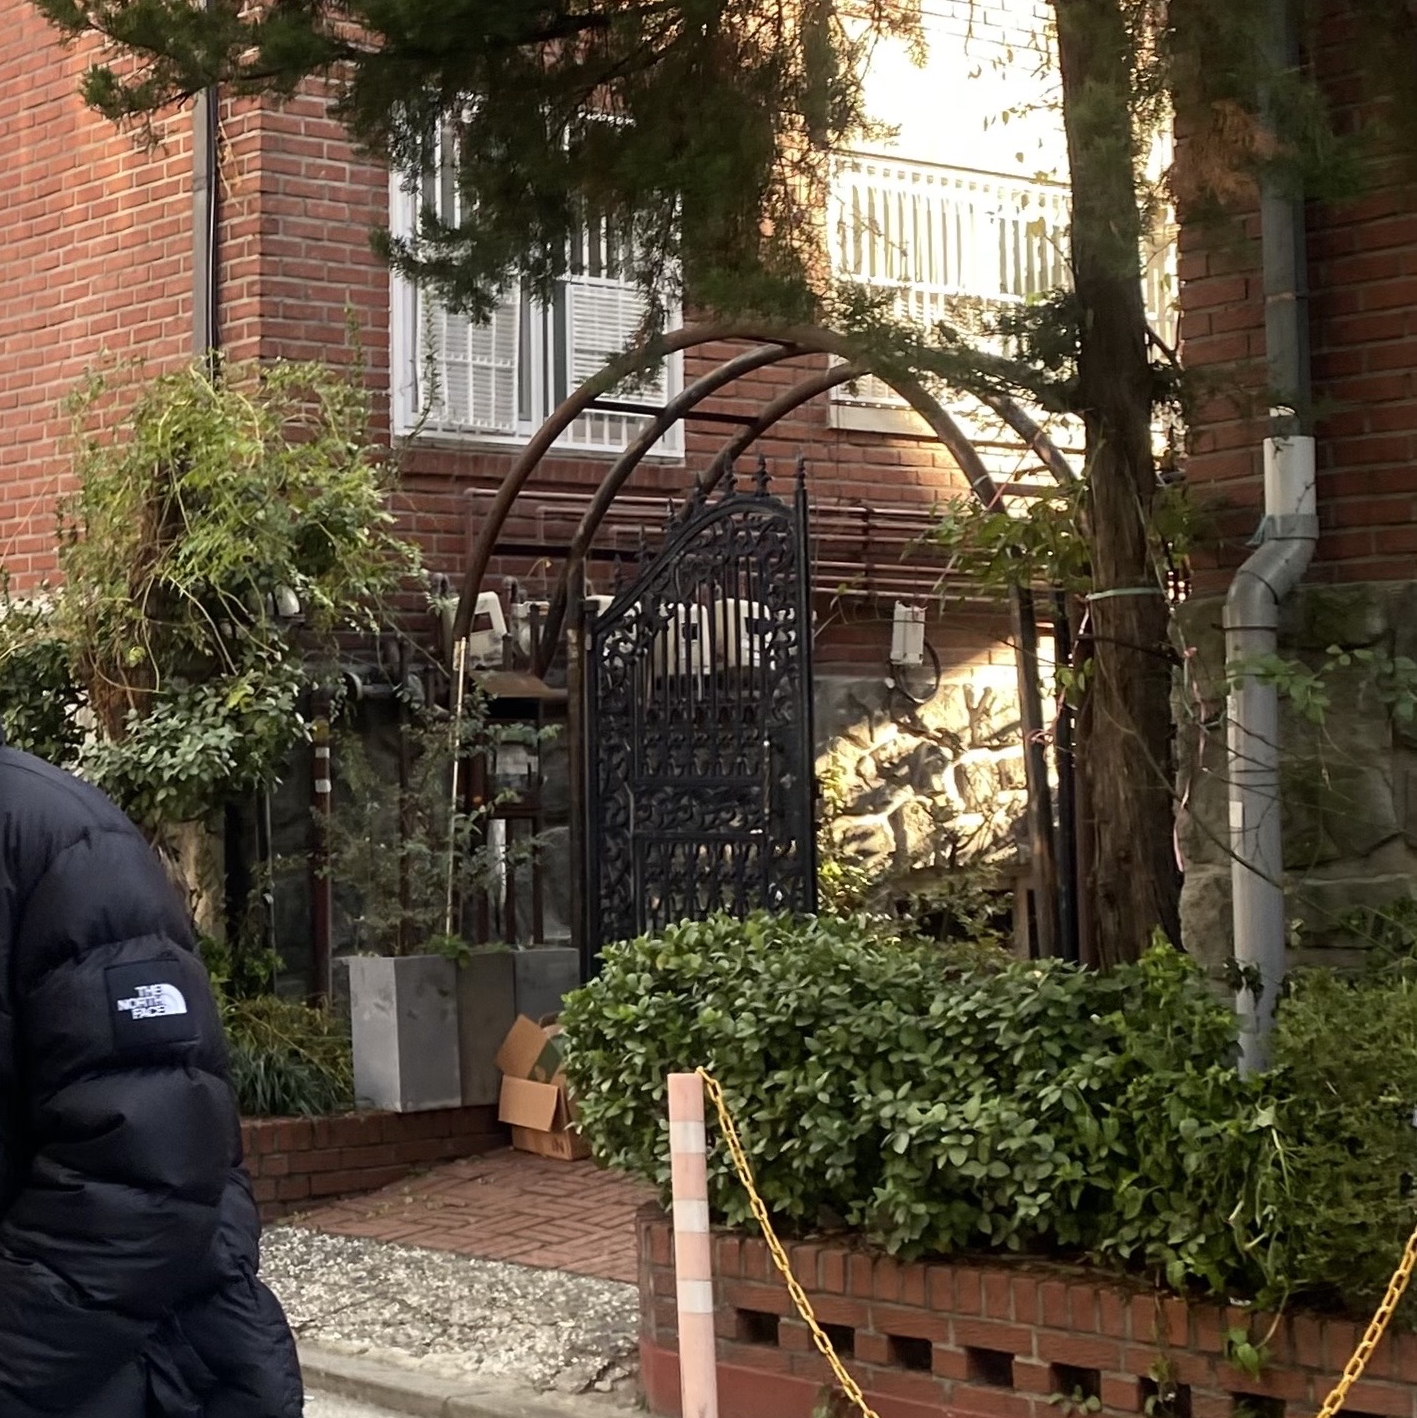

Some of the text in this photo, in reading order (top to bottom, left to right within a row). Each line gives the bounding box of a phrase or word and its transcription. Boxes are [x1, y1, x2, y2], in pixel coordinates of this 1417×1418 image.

[134, 984, 162, 998] THE
[117, 995, 165, 1011] NORTH
[132, 1005, 165, 1019] FACE
